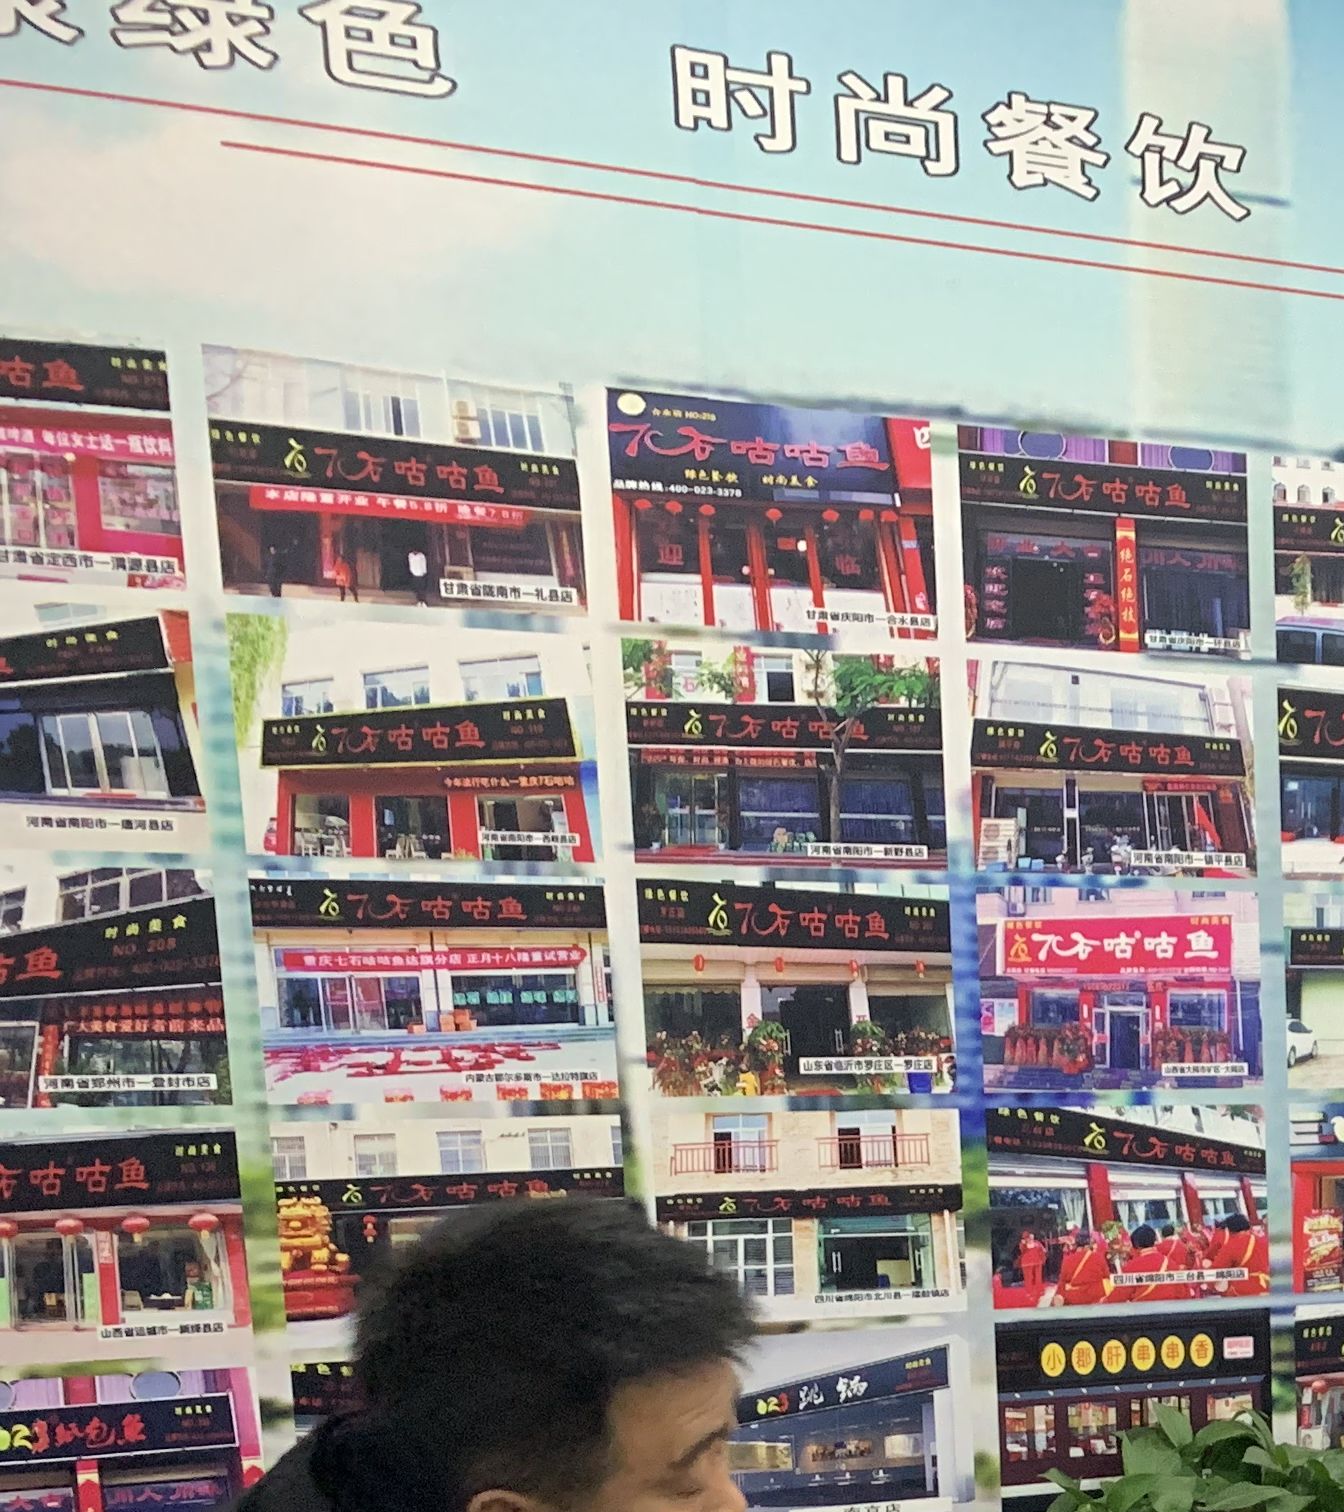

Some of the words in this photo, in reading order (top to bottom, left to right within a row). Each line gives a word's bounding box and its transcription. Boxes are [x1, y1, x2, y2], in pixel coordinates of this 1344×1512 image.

[0, 0, 457, 98] 绿色
[671, 44, 1256, 221] 时尚餐饮
